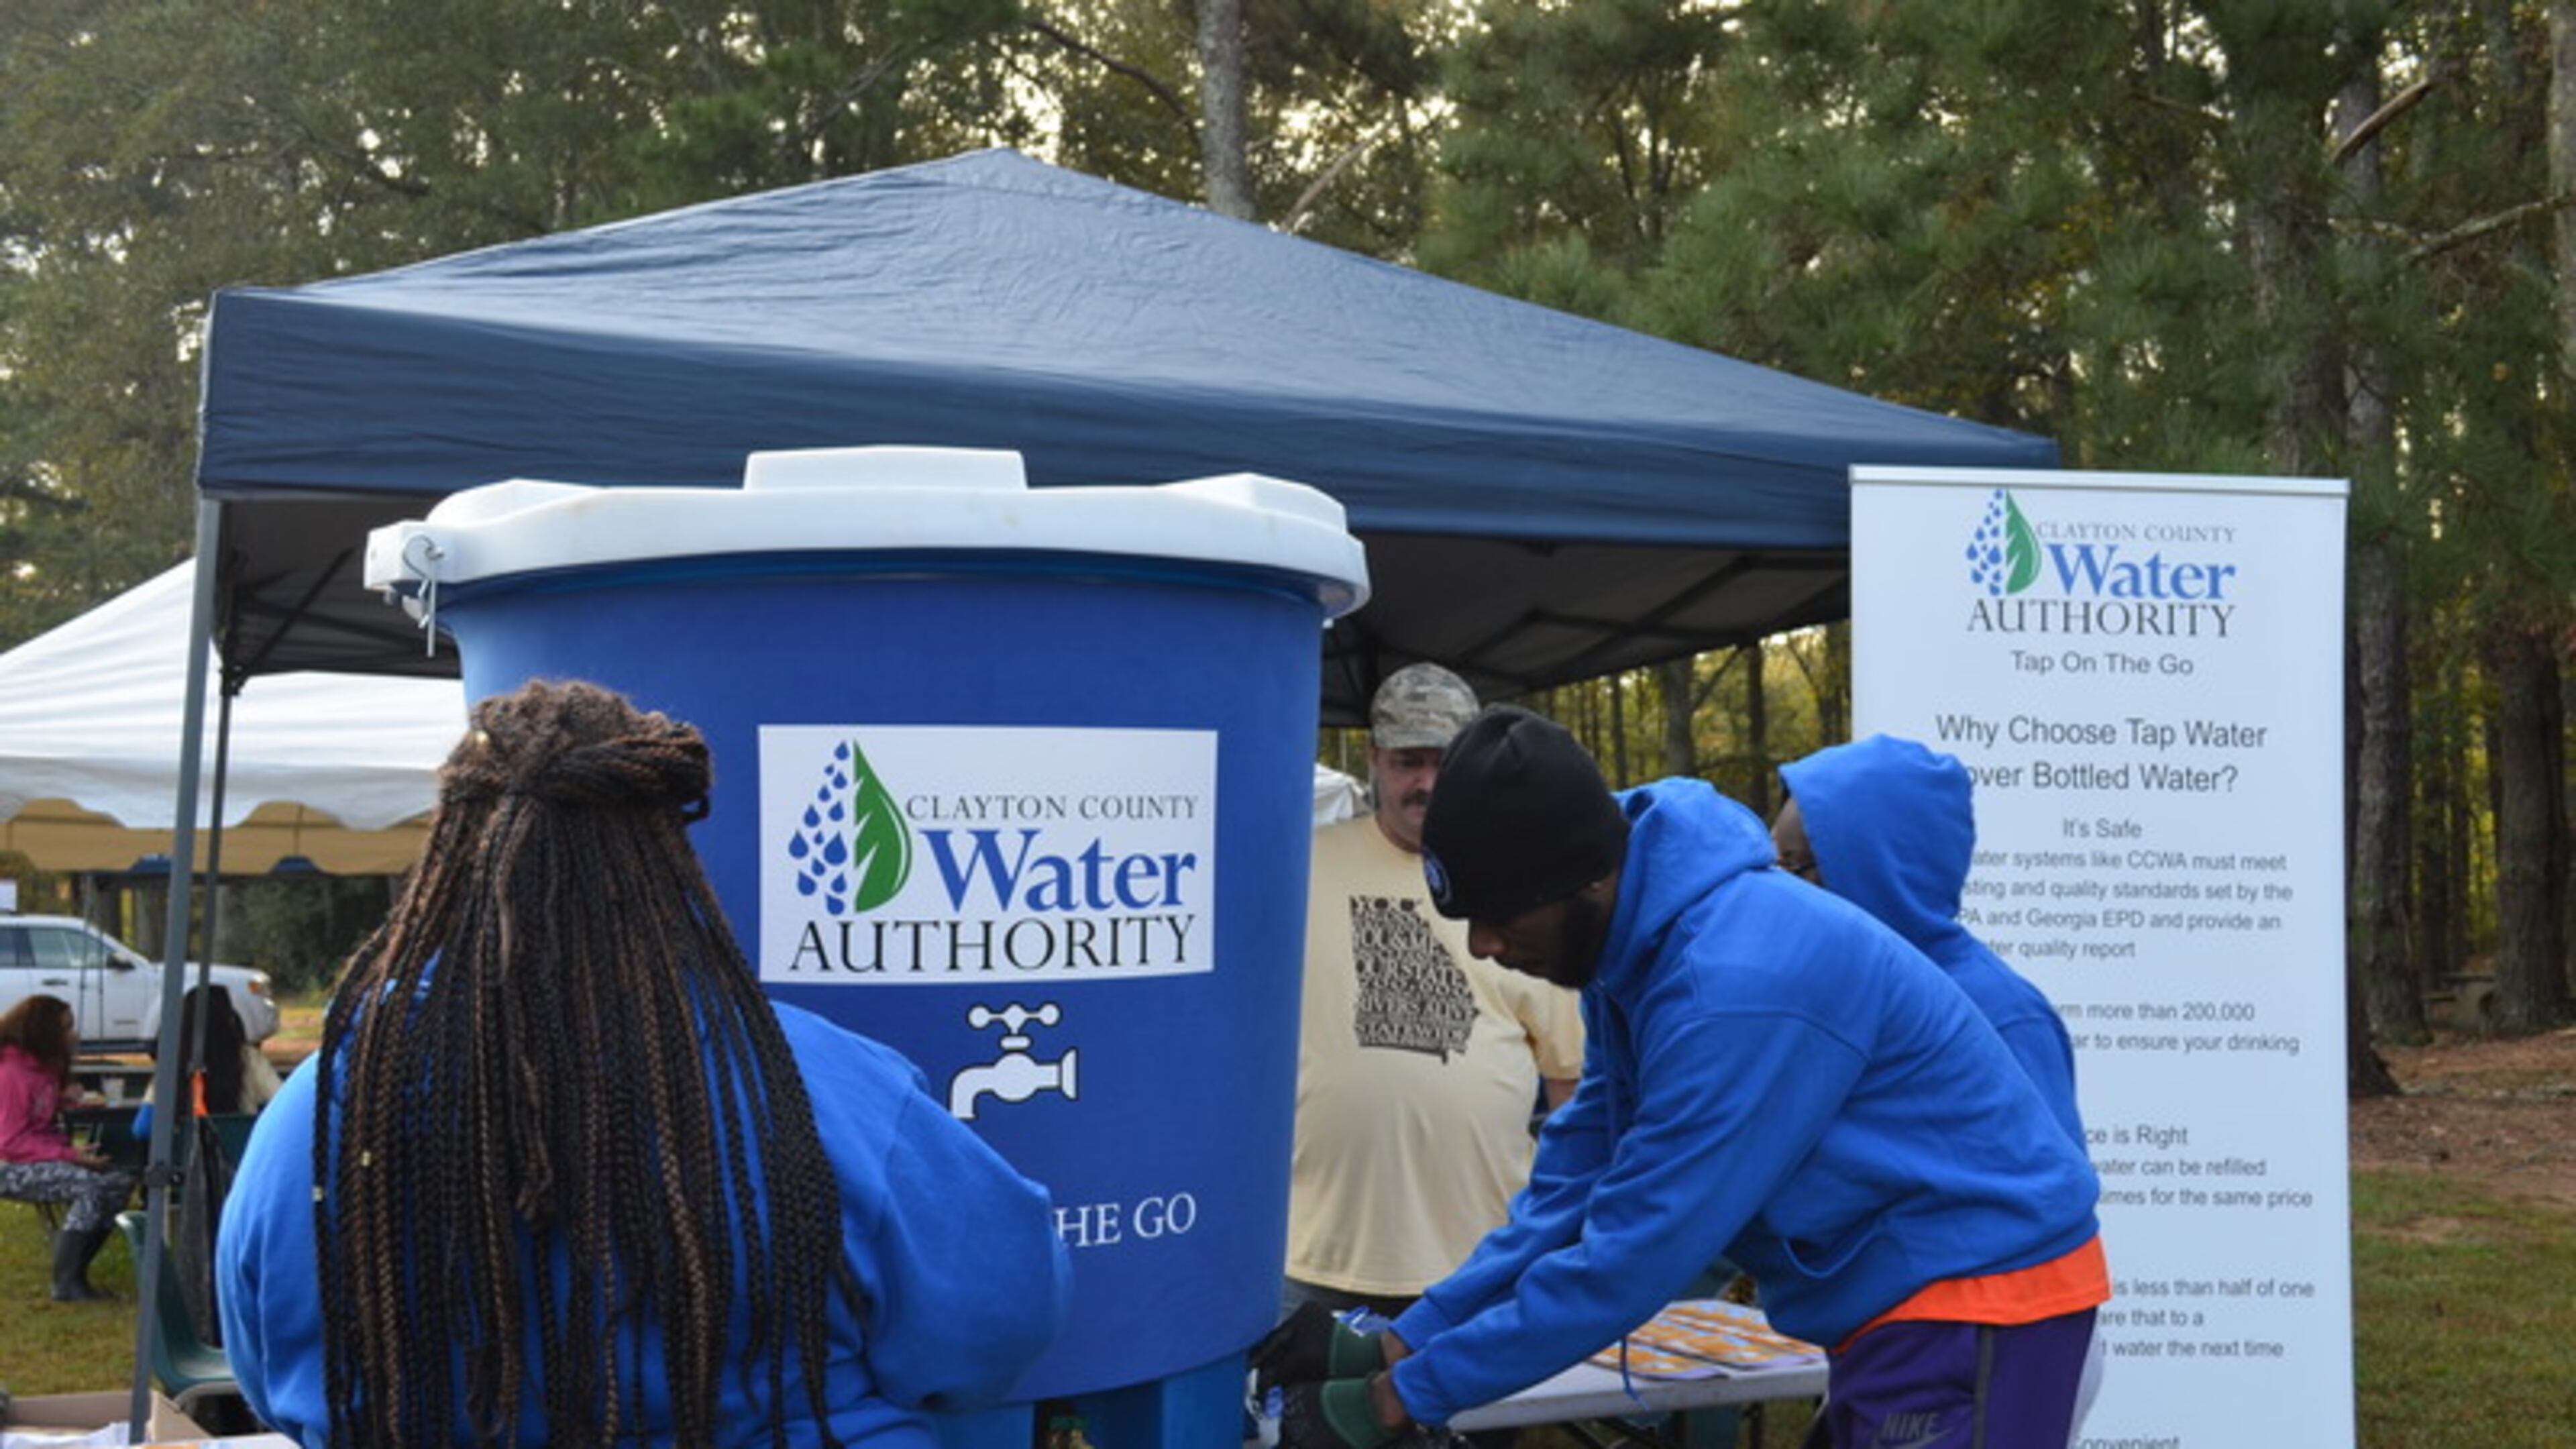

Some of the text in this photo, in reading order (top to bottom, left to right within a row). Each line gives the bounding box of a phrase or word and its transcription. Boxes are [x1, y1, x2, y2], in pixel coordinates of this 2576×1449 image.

[2037, 521, 2237, 544] CLAYTON COUNTY
[2047, 543, 2237, 599] Water
[1967, 598, 2236, 638] AUTHORITY
[2009, 649, 2194, 676] Tap On The Go
[1935, 714, 2267, 752] Why Choose Tap Water
[2032, 760, 2130, 791] Bottled
[2138, 763, 2239, 793] Water?
[905, 794, 1199, 820] CLAYTON COUNTY
[2062, 817, 2143, 840] It's Safe
[918, 828, 1197, 913] Water
[1974, 849, 2288, 872] ater systems like CCWA must meet
[1965, 879, 2294, 905] sting and quality standards set by the
[1960, 907, 2283, 933] PA and Georgia EPD and provide an
[789, 914, 1195, 974] AUTHORITY
[1988, 938, 2136, 962] ter quality report
[2086, 1004, 2135, 1021] more
[2137, 1002, 2178, 1021] than
[2093, 1032, 2113, 1051] to
[2115, 1034, 2180, 1051] ensure
[2182, 1036, 2224, 1055] your
[2226, 1033, 2300, 1057] drinking
[2112, 1124, 2131, 1146] is
[2135, 1123, 2188, 1150] Right
[2140, 1160, 2175, 1177] can
[2178, 1158, 2202, 1177] be
[2205, 1157, 2267, 1177] refilled
[2149, 1186, 2176, 1206] for
[2179, 1187, 2208, 1207] the
[2212, 1190, 2263, 1208] same
[2266, 1189, 2314, 1211] price
[1054, 1192, 1196, 1248] HE GO
[2132, 1277, 2171, 1298] less
[2173, 1278, 2214, 1297] than
[2218, 1277, 2253, 1297] half
[2255, 1277, 2275, 1298] of
[2278, 1281, 2316, 1298] one
[2131, 1308, 2166, 1328] that
[2169, 1309, 2190, 1328] to
[2192, 1311, 2205, 1328] a
[2112, 1340, 2163, 1357] water
[2166, 1339, 2197, 1358] the
[2200, 1340, 2240, 1357] next
[2243, 1340, 2285, 1358] time
[1881, 1411, 1939, 1440] NIKE
[2079, 1434, 2181, 1449] onvenient
